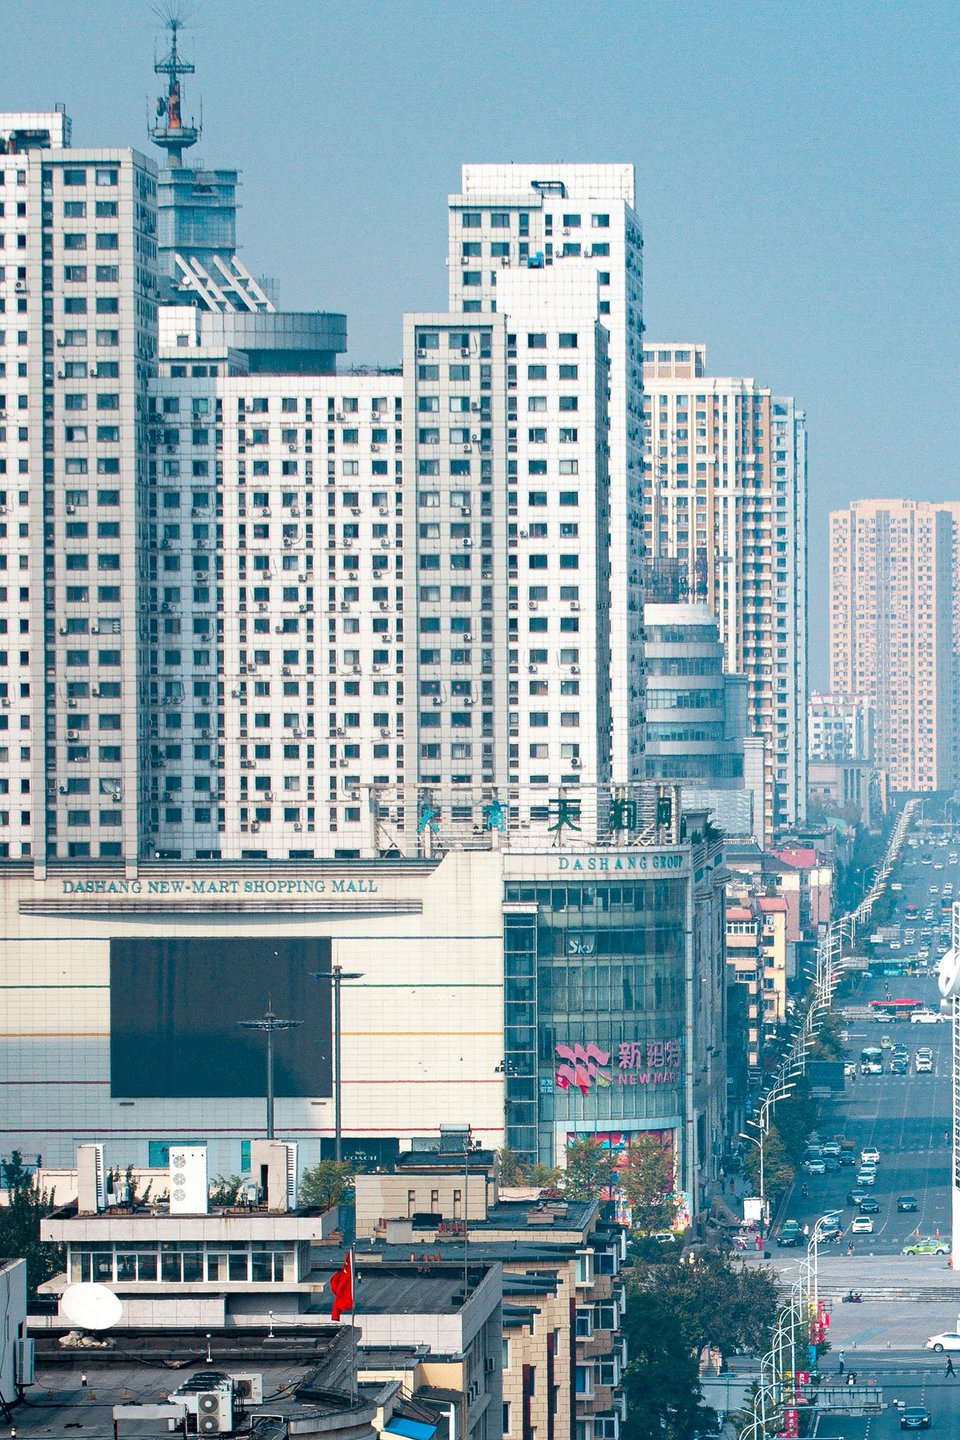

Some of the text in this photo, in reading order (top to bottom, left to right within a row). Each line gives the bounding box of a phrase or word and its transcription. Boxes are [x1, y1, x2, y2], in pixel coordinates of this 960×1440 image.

[548, 797, 672, 832] 天狗网
[559, 855, 684, 870] DASHANG GROUP
[63, 879, 378, 894] DASHANG NEW-MART SHOPPING MALL
[618, 1040, 682, 1069] 新玛特
[618, 1074, 649, 1085] NEW
